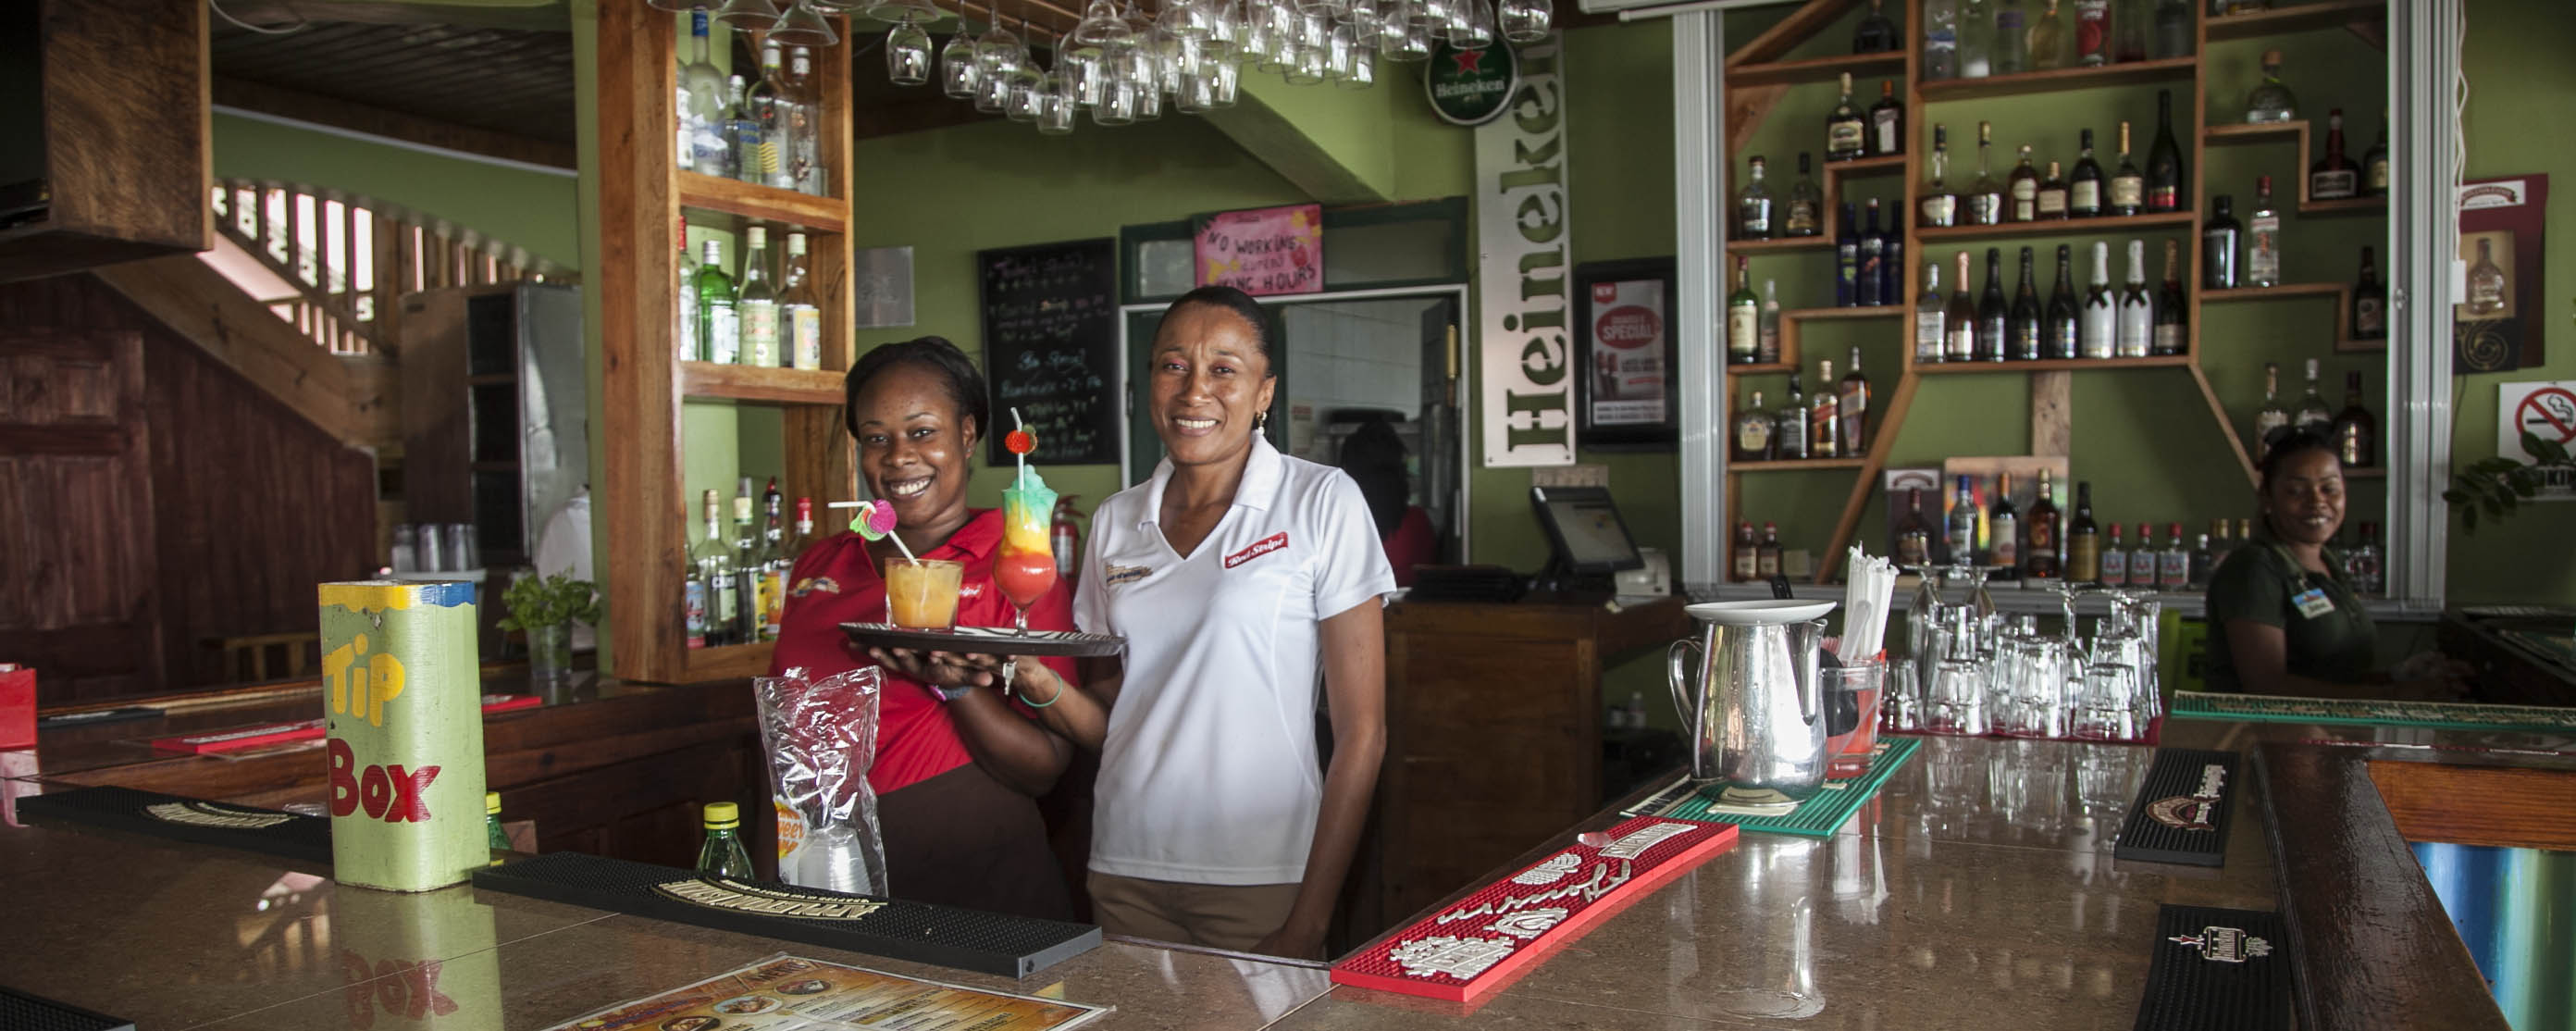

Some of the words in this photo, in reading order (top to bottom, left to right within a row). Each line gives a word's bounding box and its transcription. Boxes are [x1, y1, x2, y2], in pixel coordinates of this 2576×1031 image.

[1206, 230, 1229, 252] NO
[1234, 233, 1296, 255] WORKING
[1500, 32, 1569, 453] Heineken
[1263, 263, 1316, 291] HOURS
[1603, 323, 1654, 341] SPECIAL
[1228, 552, 1251, 566] Red
[1251, 536, 1285, 555] Stripe
[322, 633, 405, 727] Tip
[327, 738, 441, 823] Box
